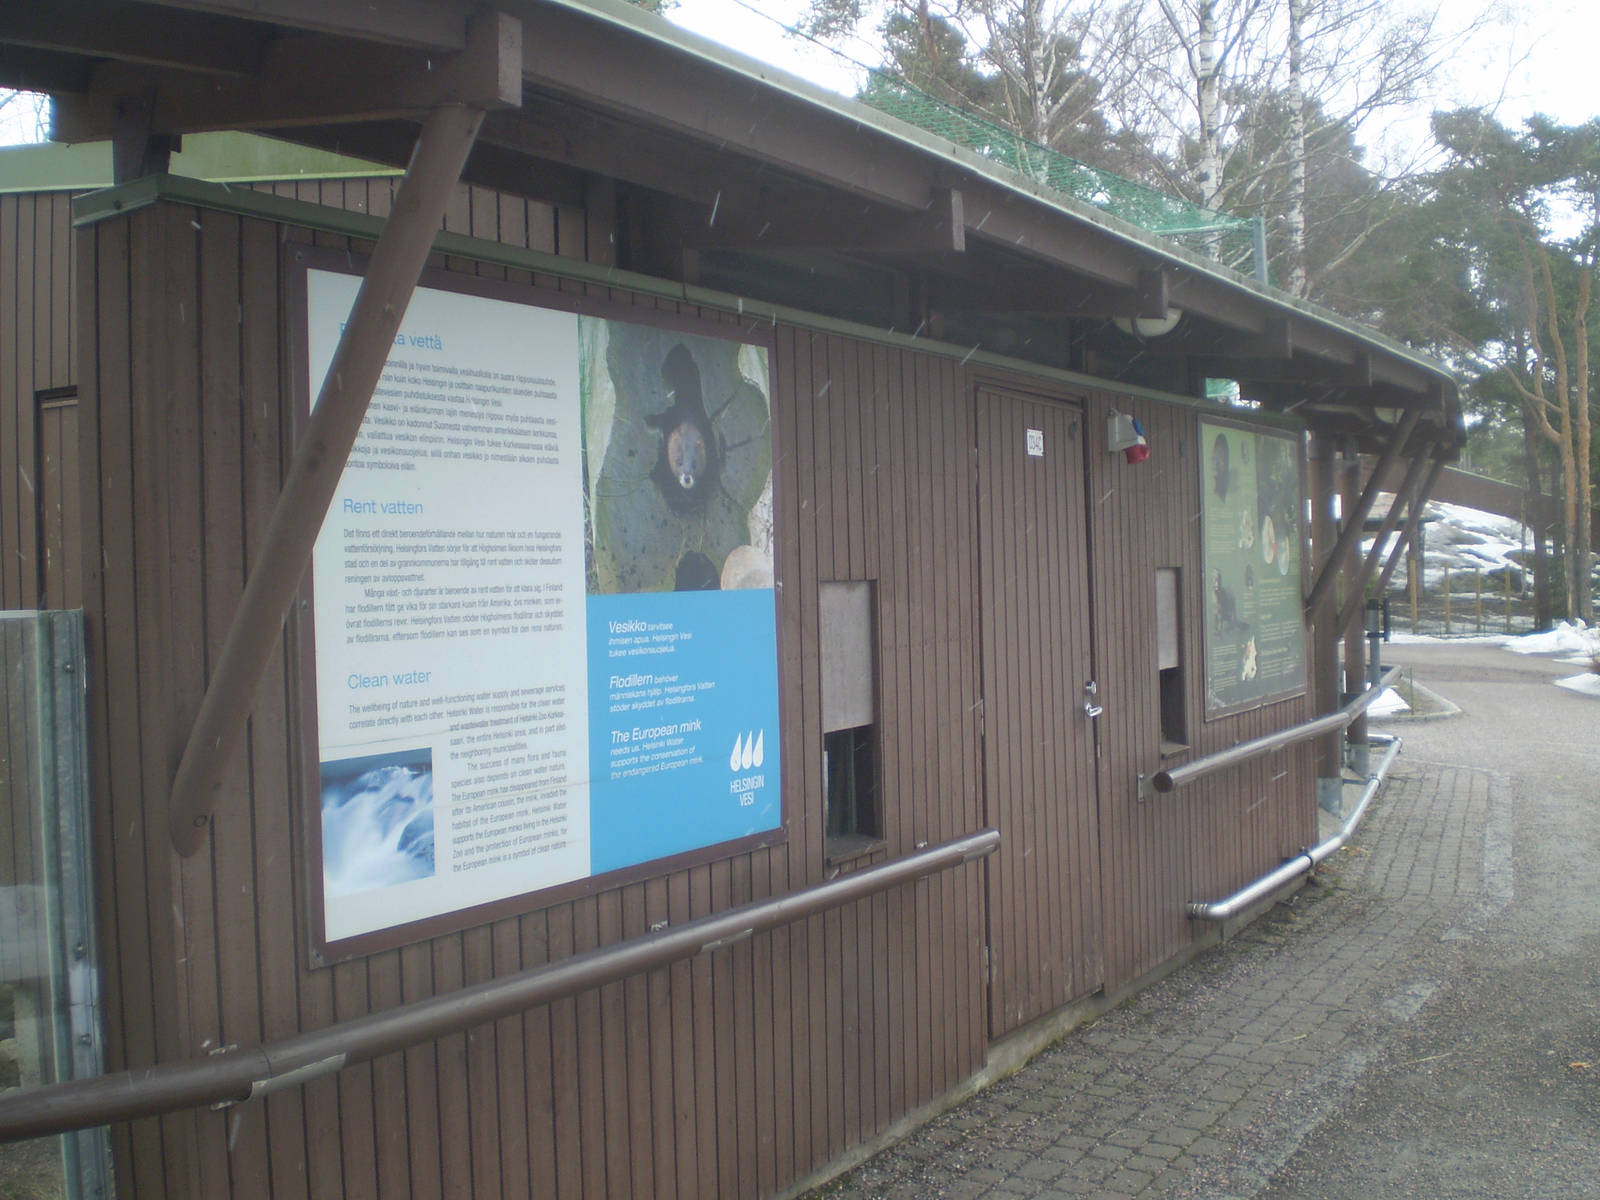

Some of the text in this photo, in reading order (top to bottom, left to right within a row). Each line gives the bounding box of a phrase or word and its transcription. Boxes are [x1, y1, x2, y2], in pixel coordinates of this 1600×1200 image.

[410, 332, 442, 351] vettä
[343, 498, 424, 515] Rent vatten
[608, 619, 648, 634] Vesikko
[347, 672, 432, 690] Clean water
[609, 673, 653, 689] Flodillern
[611, 719, 702, 744] The European mink
[730, 775, 764, 793] HELSINGIN
[739, 793, 754, 807] VESI
